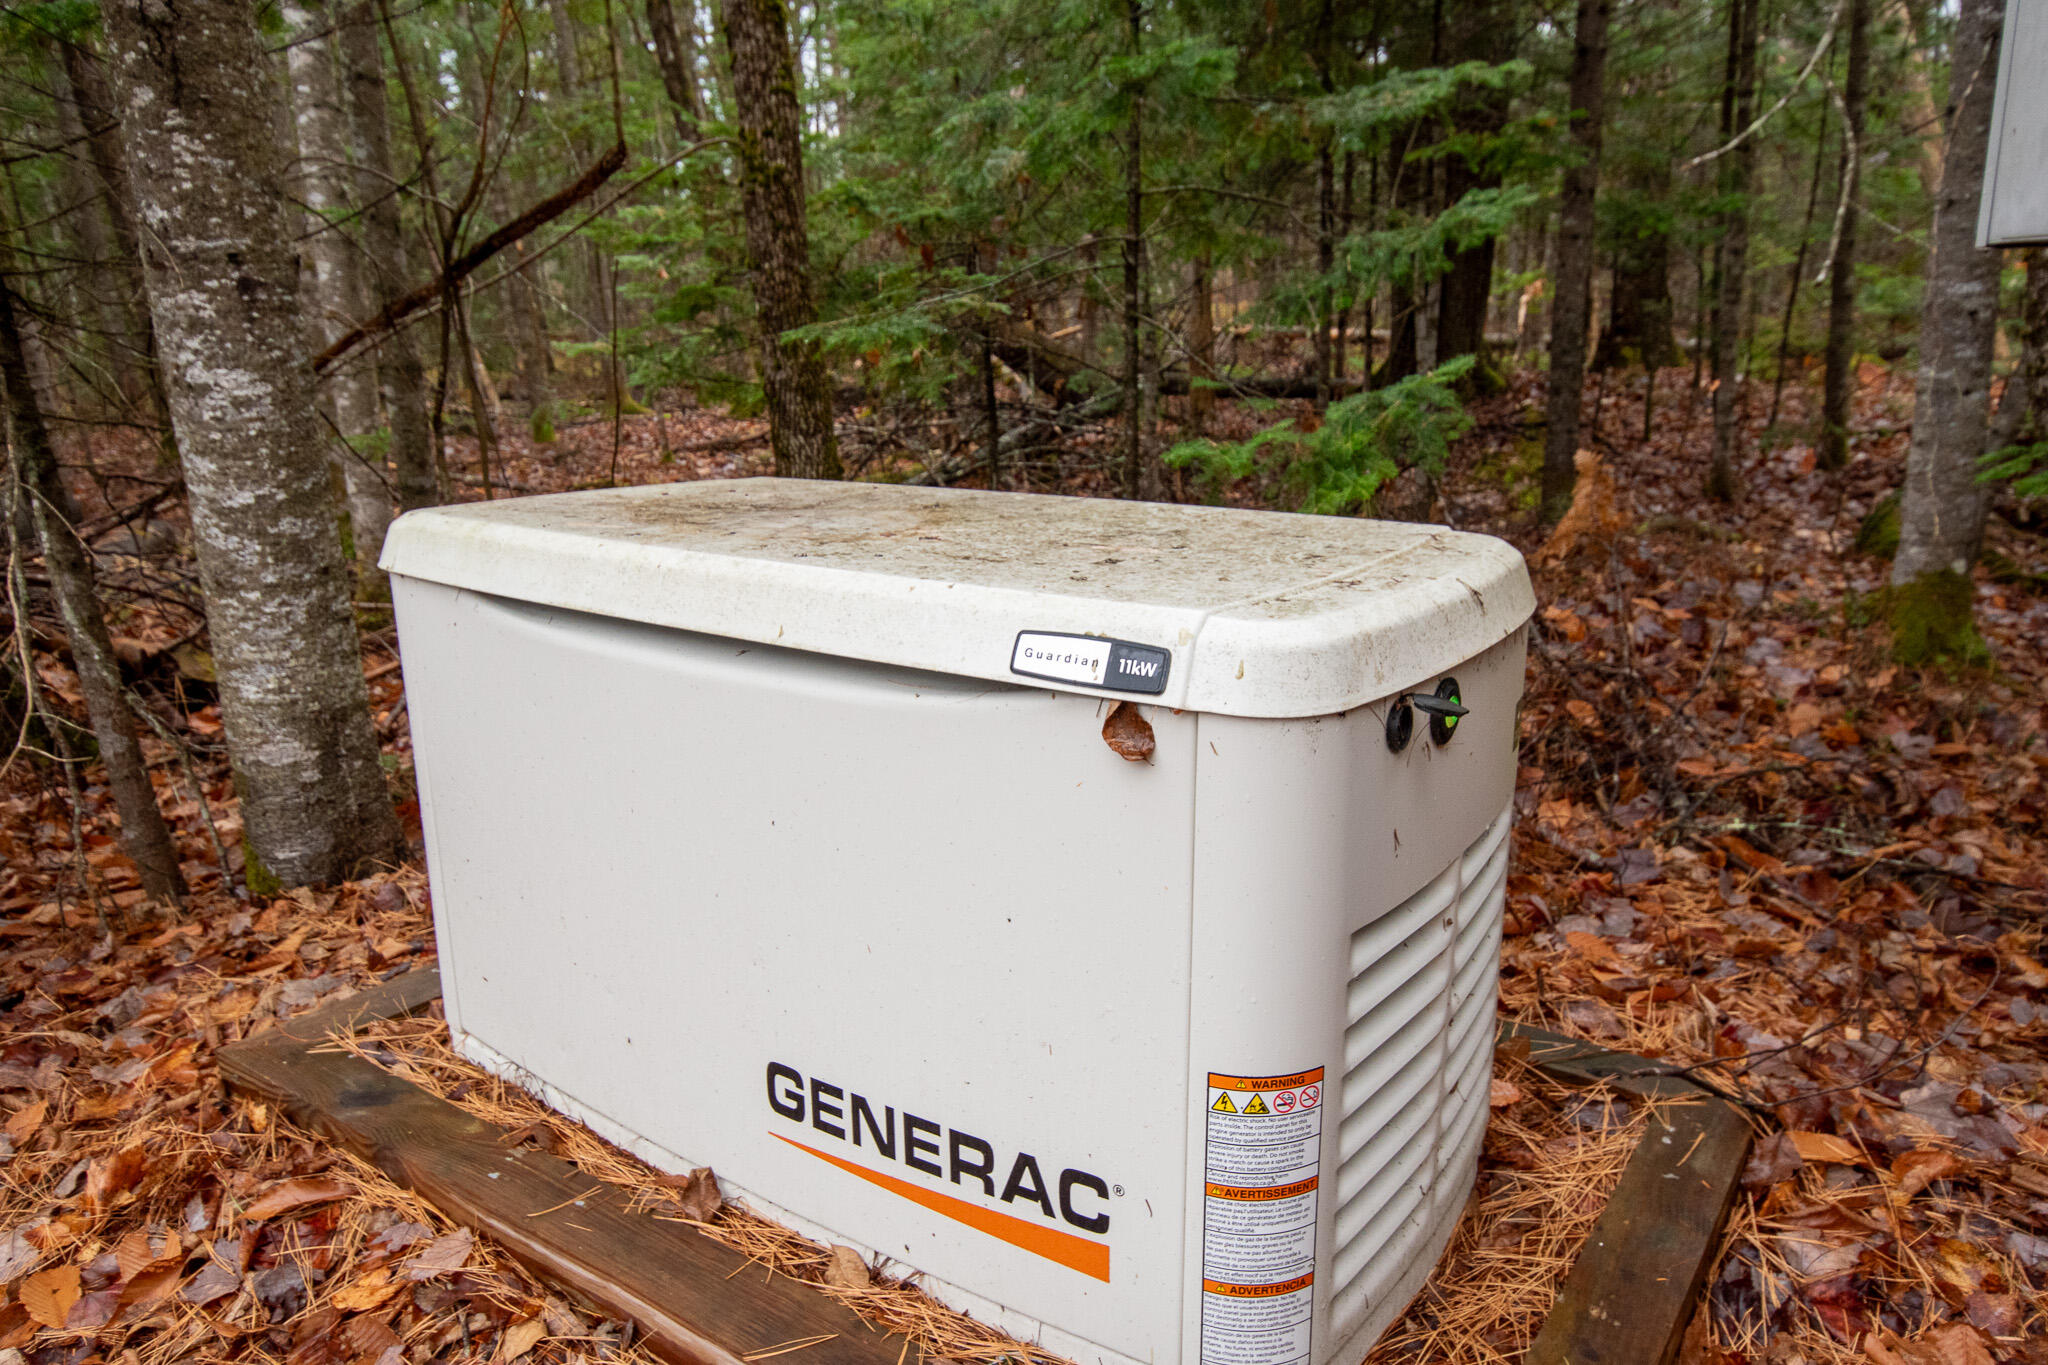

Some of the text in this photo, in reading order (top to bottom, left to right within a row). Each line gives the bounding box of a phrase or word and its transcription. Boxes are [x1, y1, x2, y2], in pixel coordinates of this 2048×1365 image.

[1025, 648, 1157, 677] Guardian 11kW
[1251, 1076, 1305, 1089] WARNING
[767, 1061, 1110, 1234] GENERAC
[1224, 1180, 1315, 1199] AVERTISSEMENT
[1230, 1278, 1306, 1296] ADVERTENCIA
